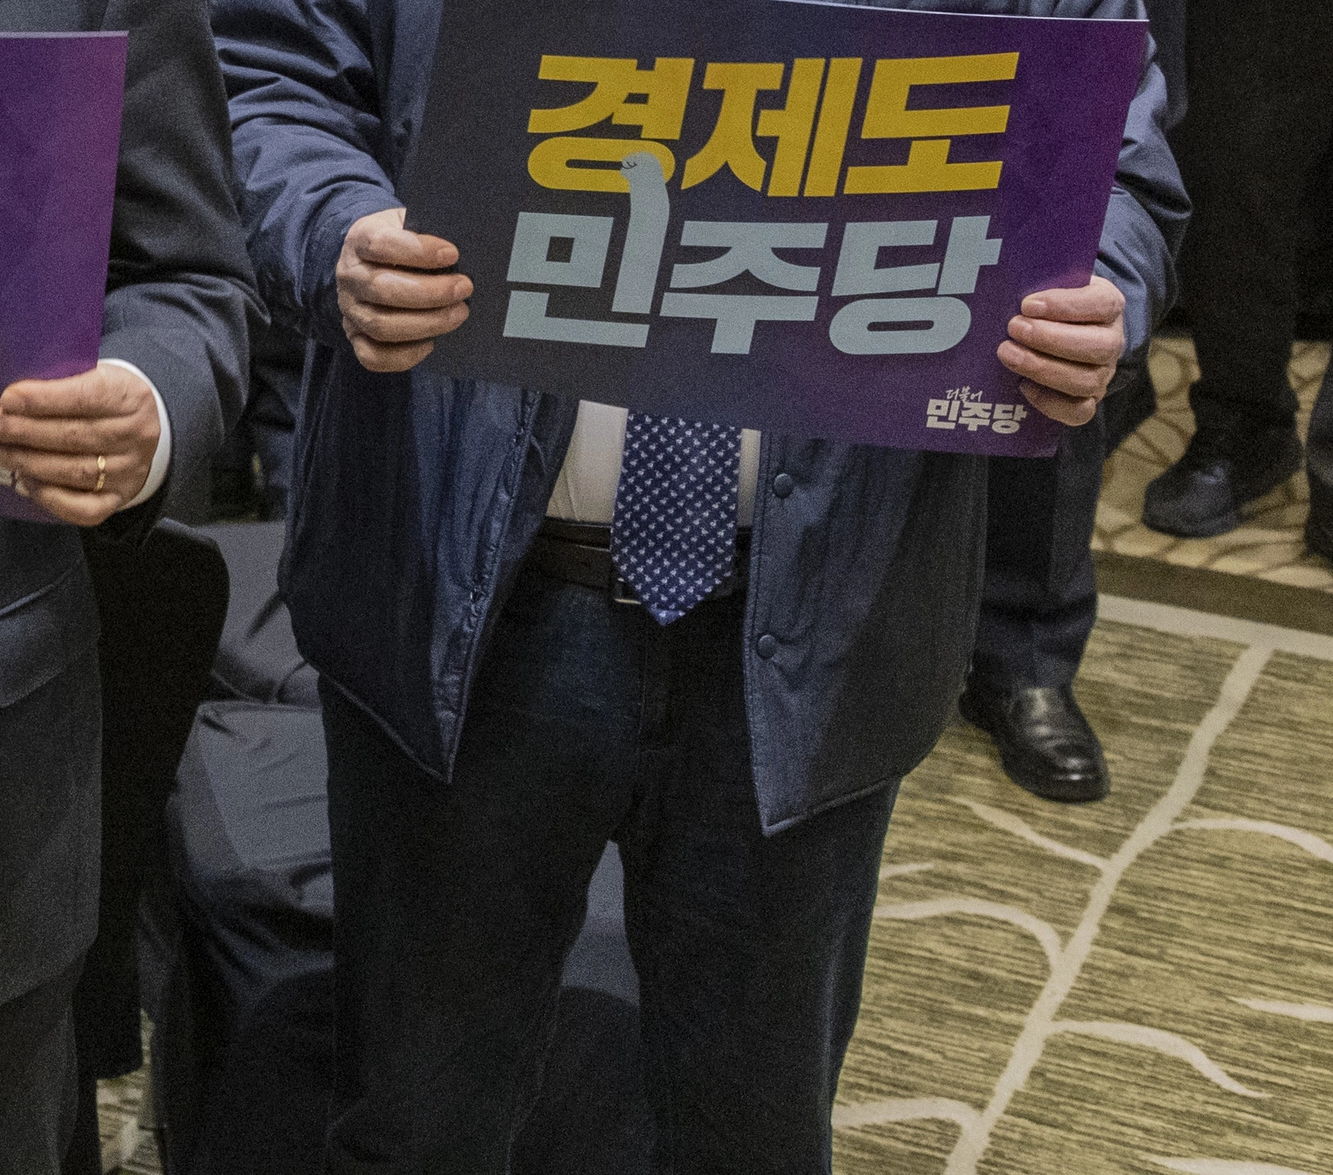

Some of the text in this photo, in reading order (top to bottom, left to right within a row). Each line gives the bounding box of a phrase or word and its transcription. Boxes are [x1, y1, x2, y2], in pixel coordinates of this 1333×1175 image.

[527, 51, 1020, 197] 경제도
[502, 151, 1004, 356] 민주당
[925, 398, 1028, 435] 민주당
[945, 386, 984, 405] 더불어
